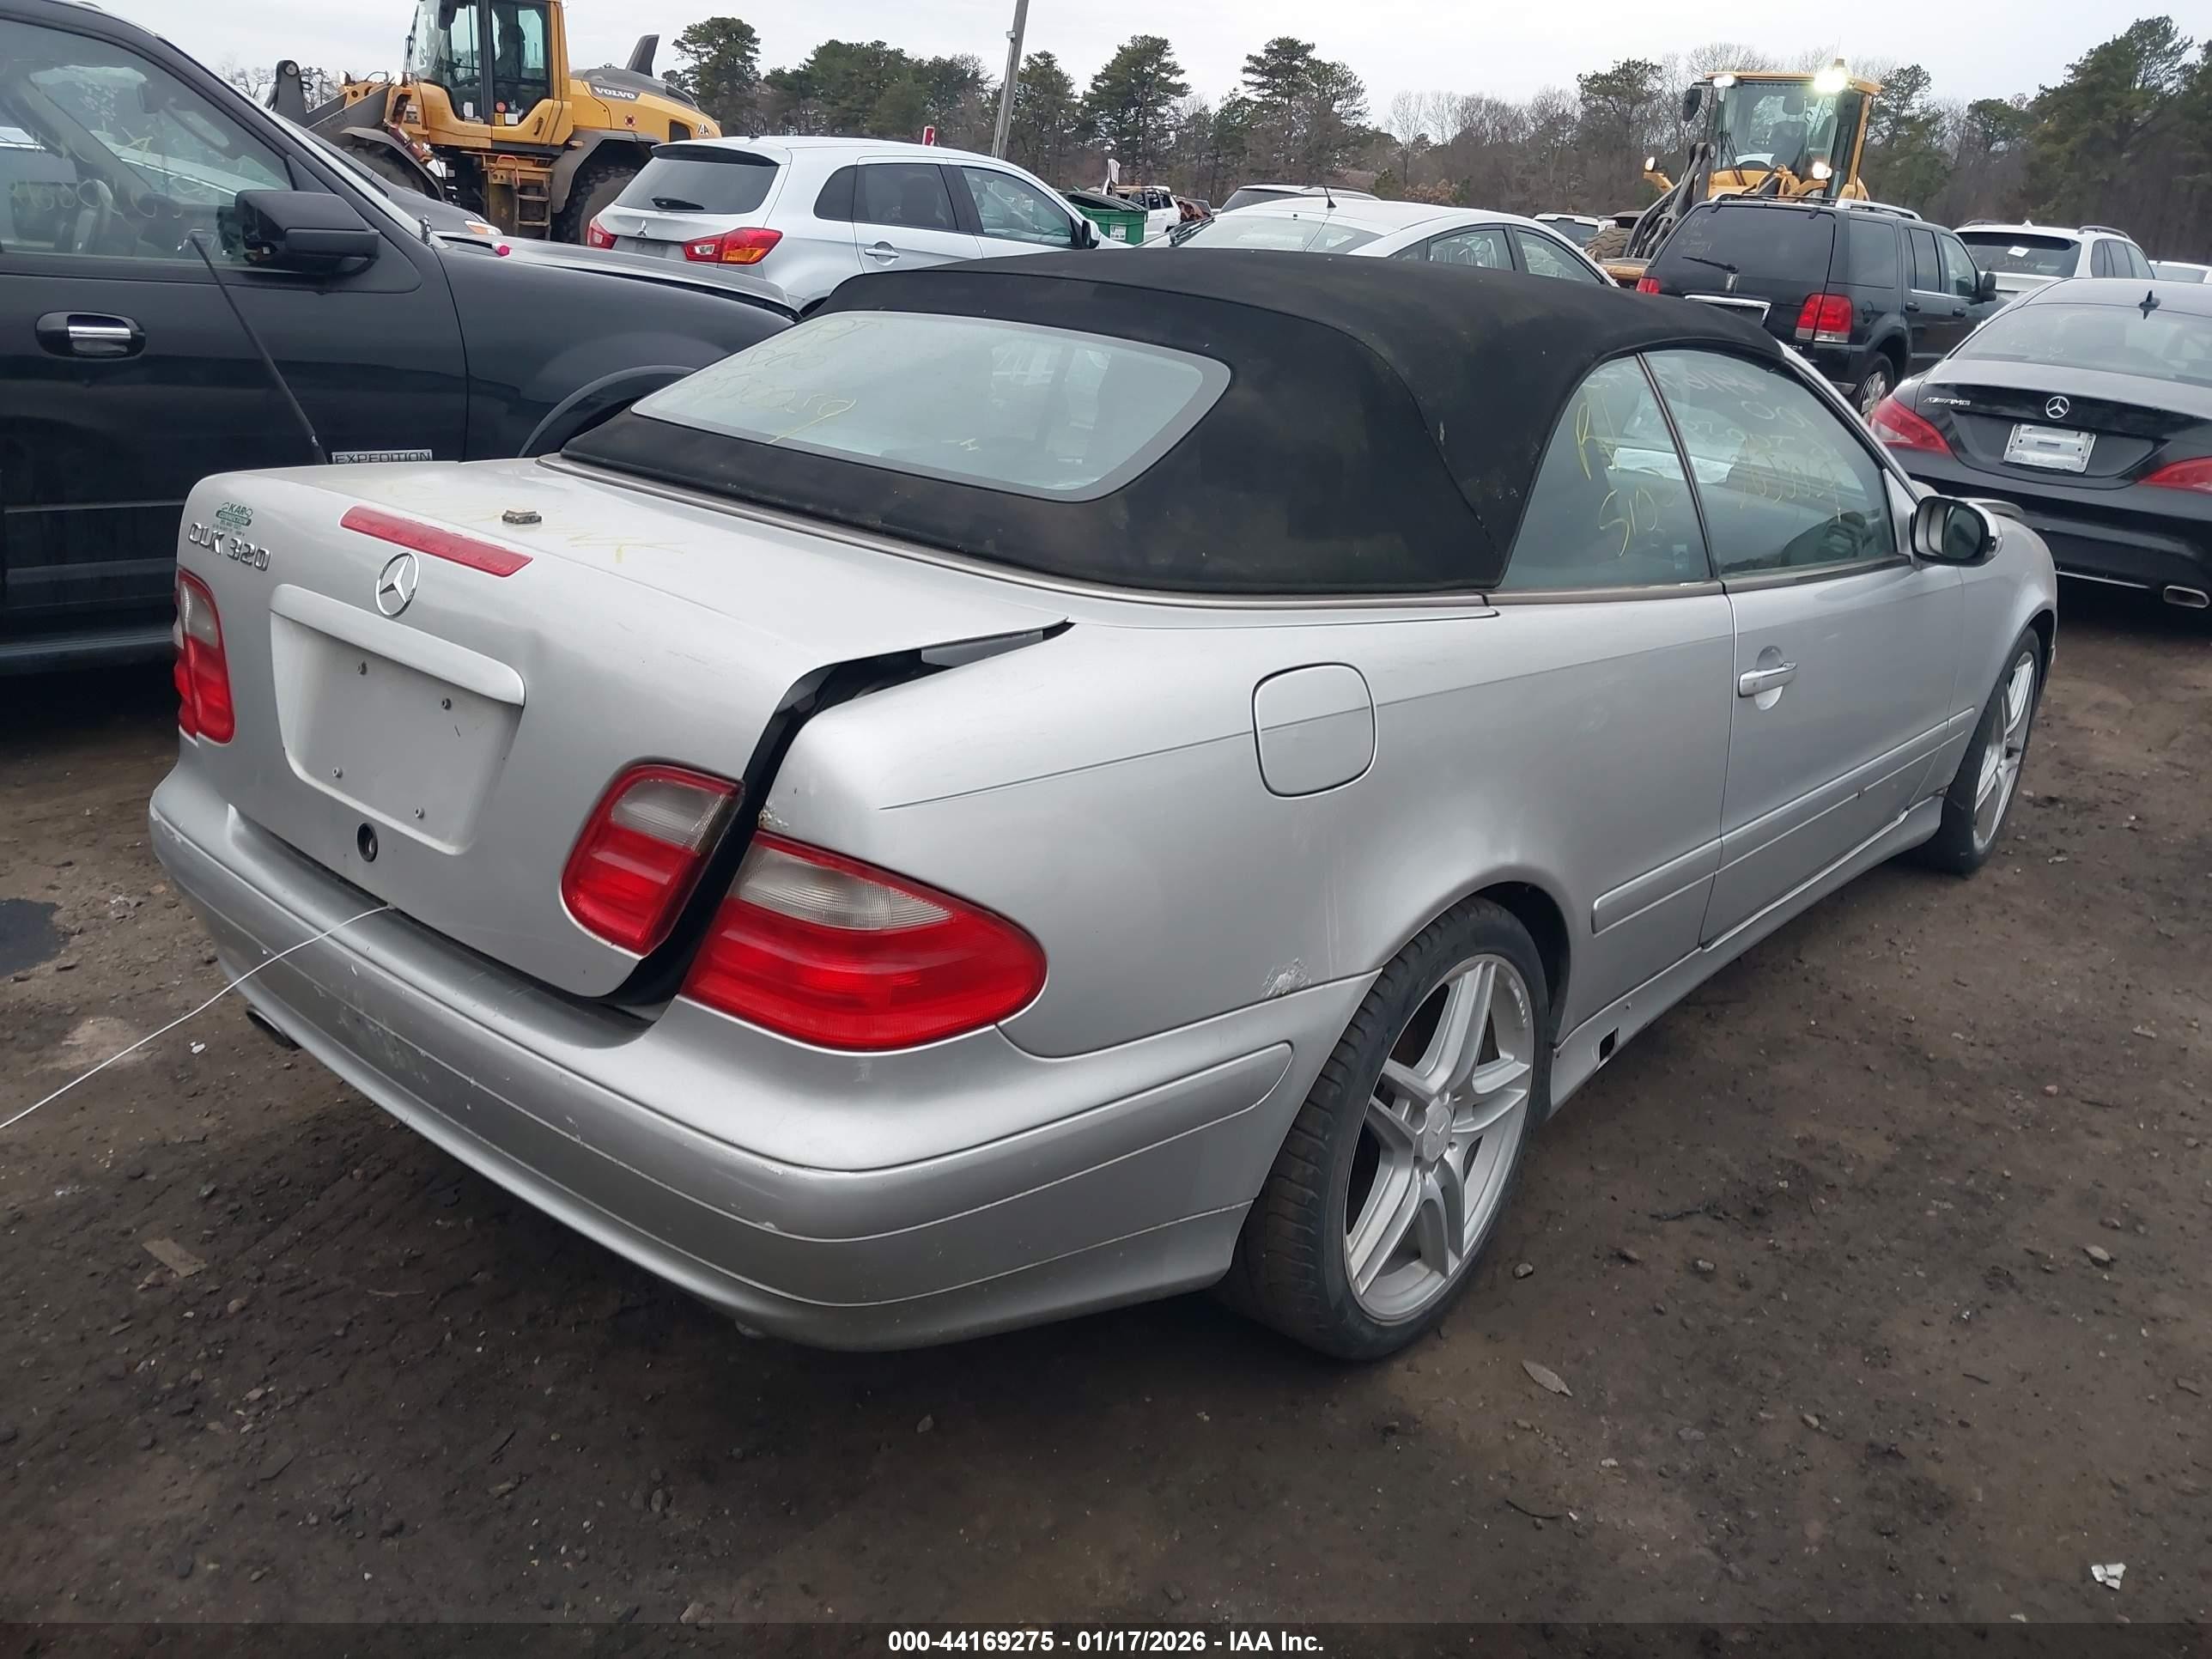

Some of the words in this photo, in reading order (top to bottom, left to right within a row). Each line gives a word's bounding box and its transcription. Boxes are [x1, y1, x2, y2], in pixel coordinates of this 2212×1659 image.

[593, 87, 635, 100] VOLVO
[335, 451, 431, 465] EXPEDITION
[188, 522, 225, 555] CLK
[227, 537, 271, 572] 320
